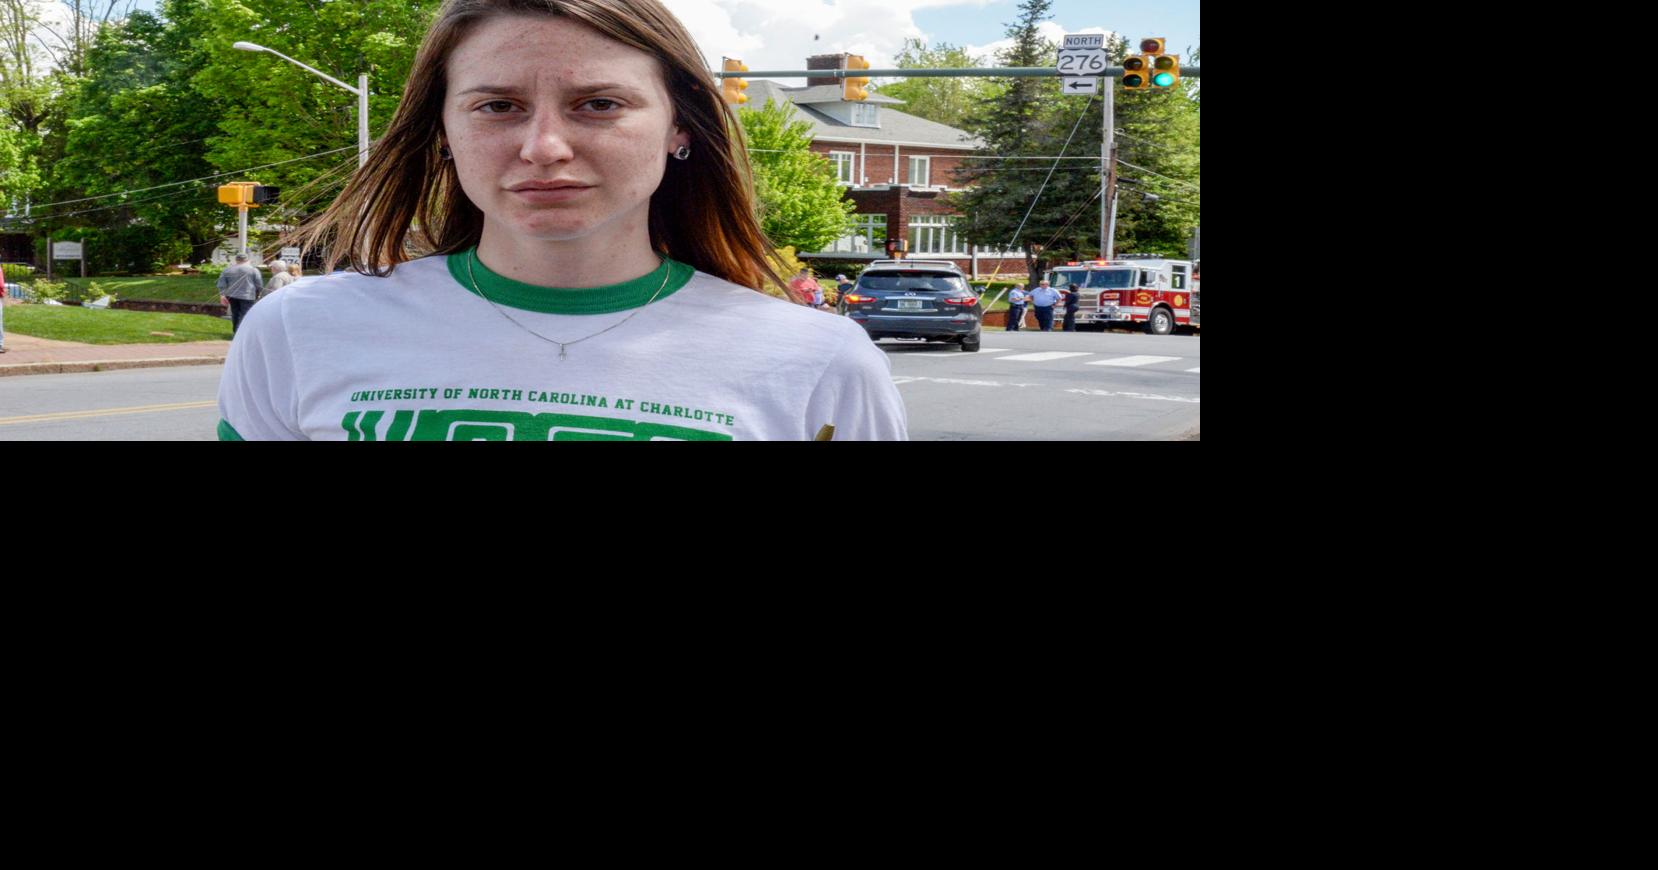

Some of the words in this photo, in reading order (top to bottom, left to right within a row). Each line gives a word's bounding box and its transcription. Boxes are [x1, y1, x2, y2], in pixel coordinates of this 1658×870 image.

[1065, 36, 1101, 46] NORTH
[1060, 54, 1103, 70] 276
[1174, 275, 1181, 288] 1
[351, 388, 438, 402] UNIVERSITY
[443, 388, 463, 400] OF
[468, 388, 523, 401] NORTH
[528, 390, 608, 408] CAROLINA
[614, 398, 635, 410] AT
[640, 401, 735, 426] CHARLOTTE
